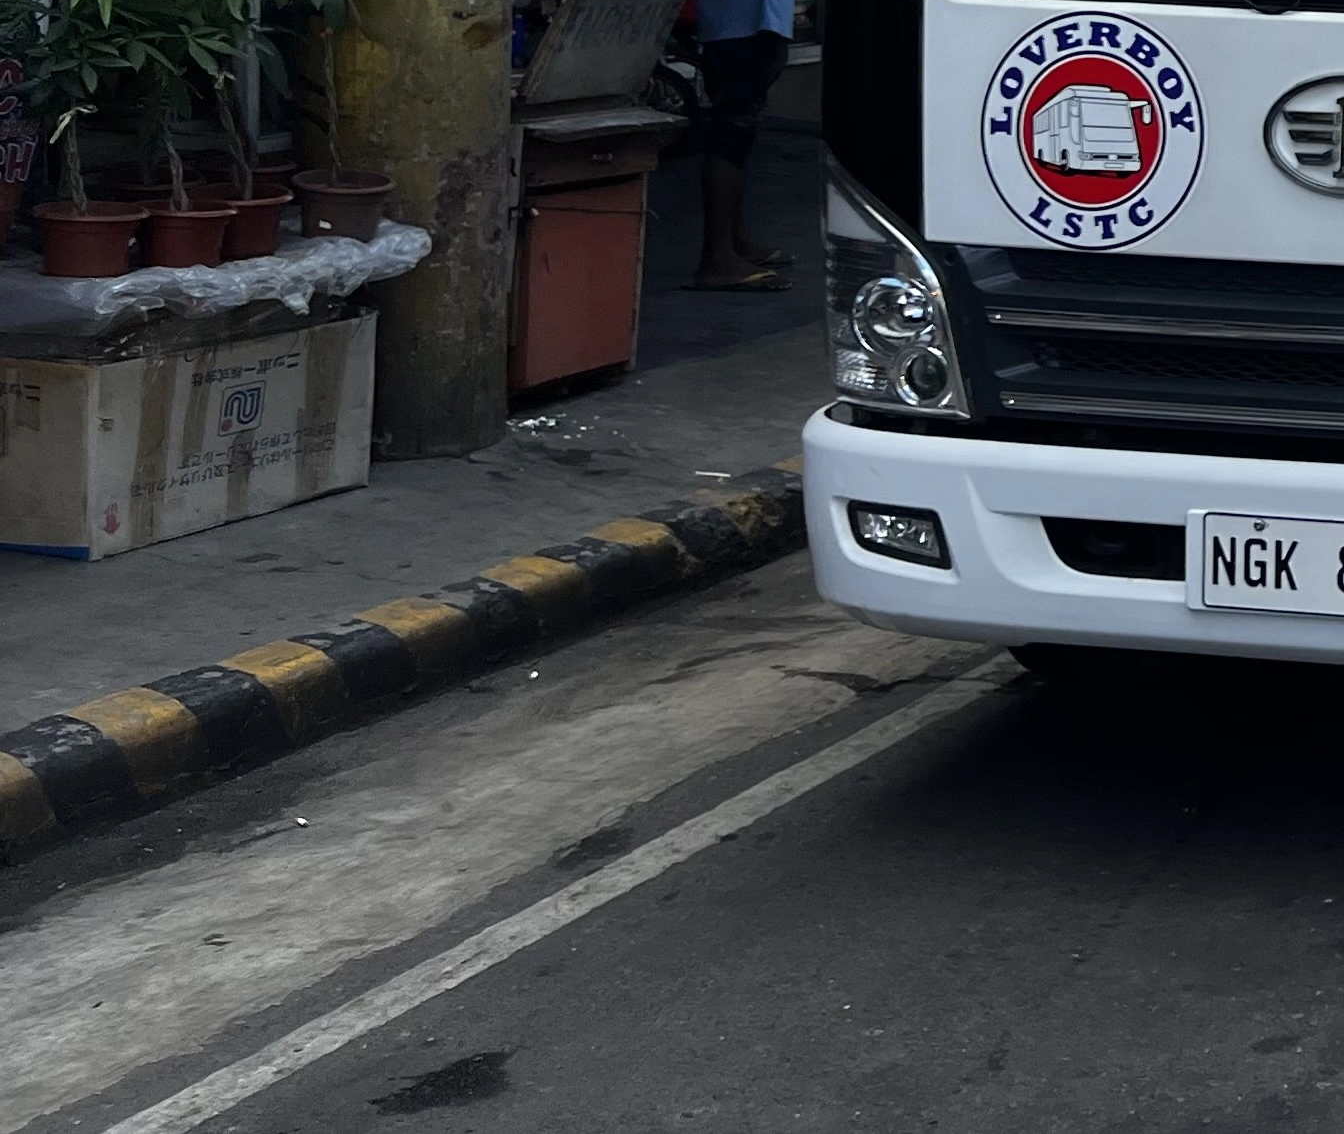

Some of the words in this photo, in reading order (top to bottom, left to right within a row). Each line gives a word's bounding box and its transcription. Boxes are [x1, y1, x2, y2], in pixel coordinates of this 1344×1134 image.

[989, 21, 1196, 137] LOVERBOY
[1028, 196, 1156, 242] LSTC
[1211, 535, 1299, 591] NGK
